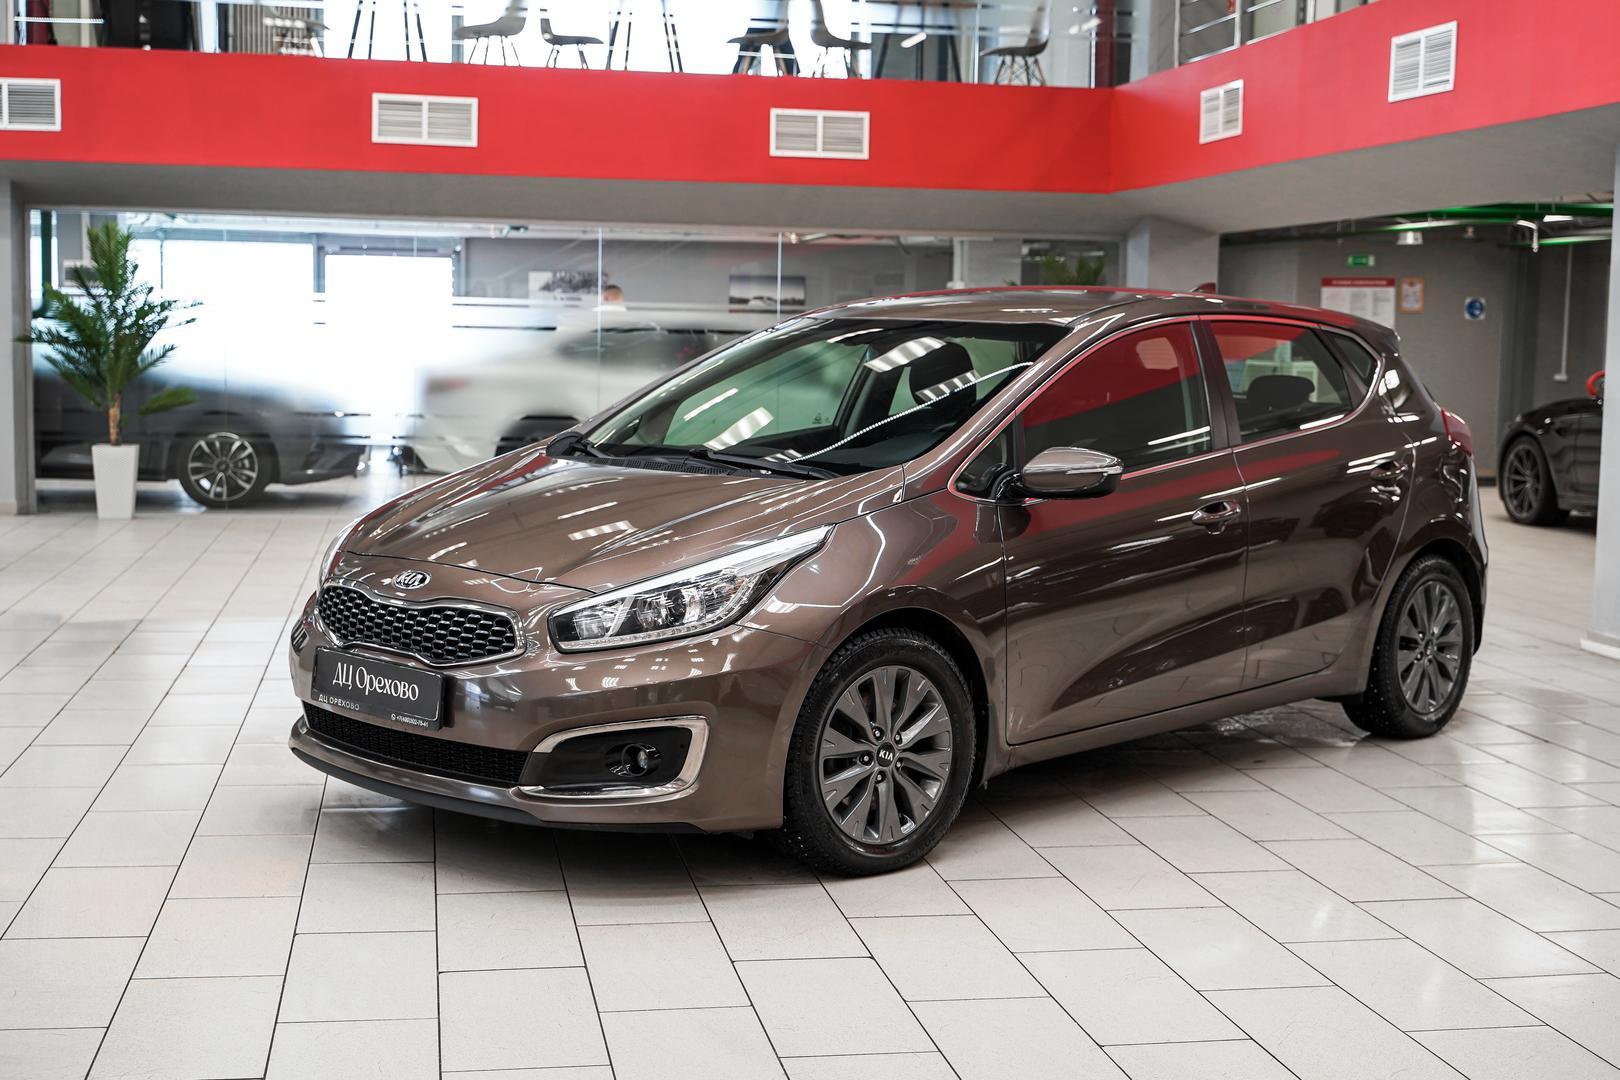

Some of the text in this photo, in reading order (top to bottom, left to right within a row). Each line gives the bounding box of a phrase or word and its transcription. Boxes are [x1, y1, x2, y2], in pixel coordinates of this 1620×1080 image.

[395, 571, 427, 588] KIA
[332, 661, 419, 701] ДЦ Орехово
[318, 693, 360, 711] ДЦ ОРЕХОВО
[879, 749, 893, 761] KIA
